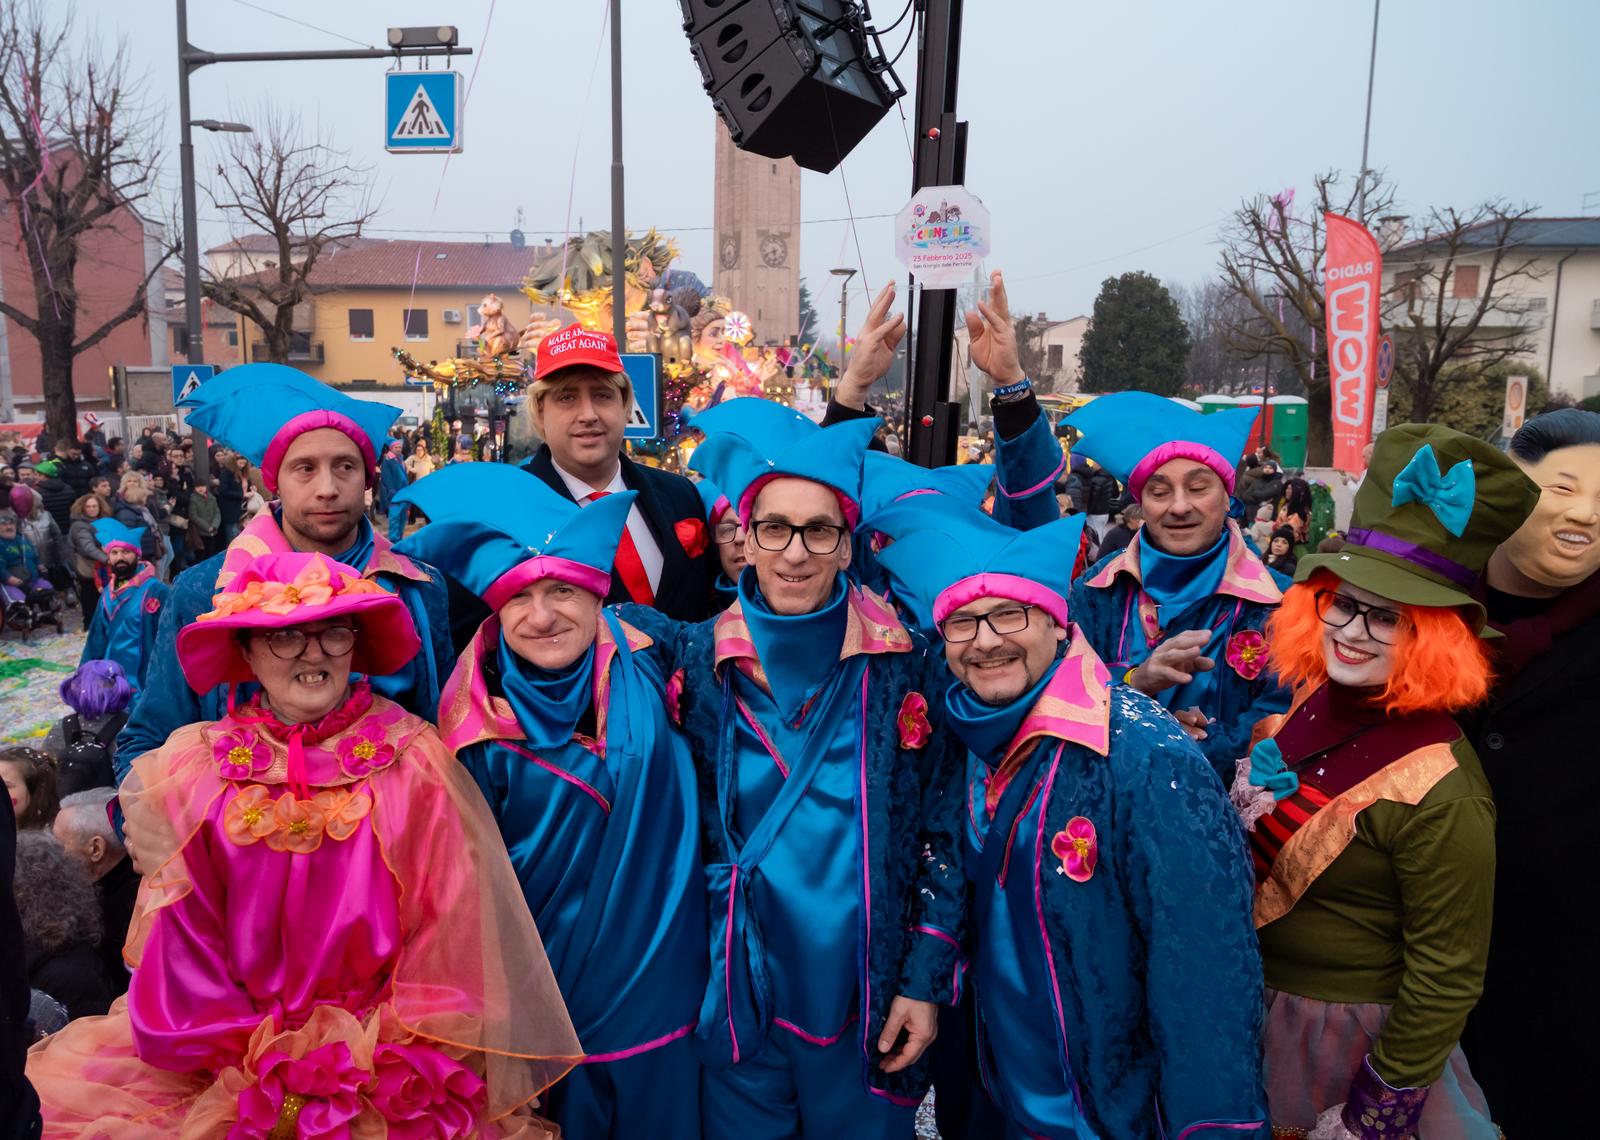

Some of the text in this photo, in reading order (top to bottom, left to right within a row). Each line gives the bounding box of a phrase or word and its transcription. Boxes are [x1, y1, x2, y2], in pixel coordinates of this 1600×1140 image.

[547, 330, 571, 347] MAKE
[550, 338, 607, 356] GREAT AGAIN
